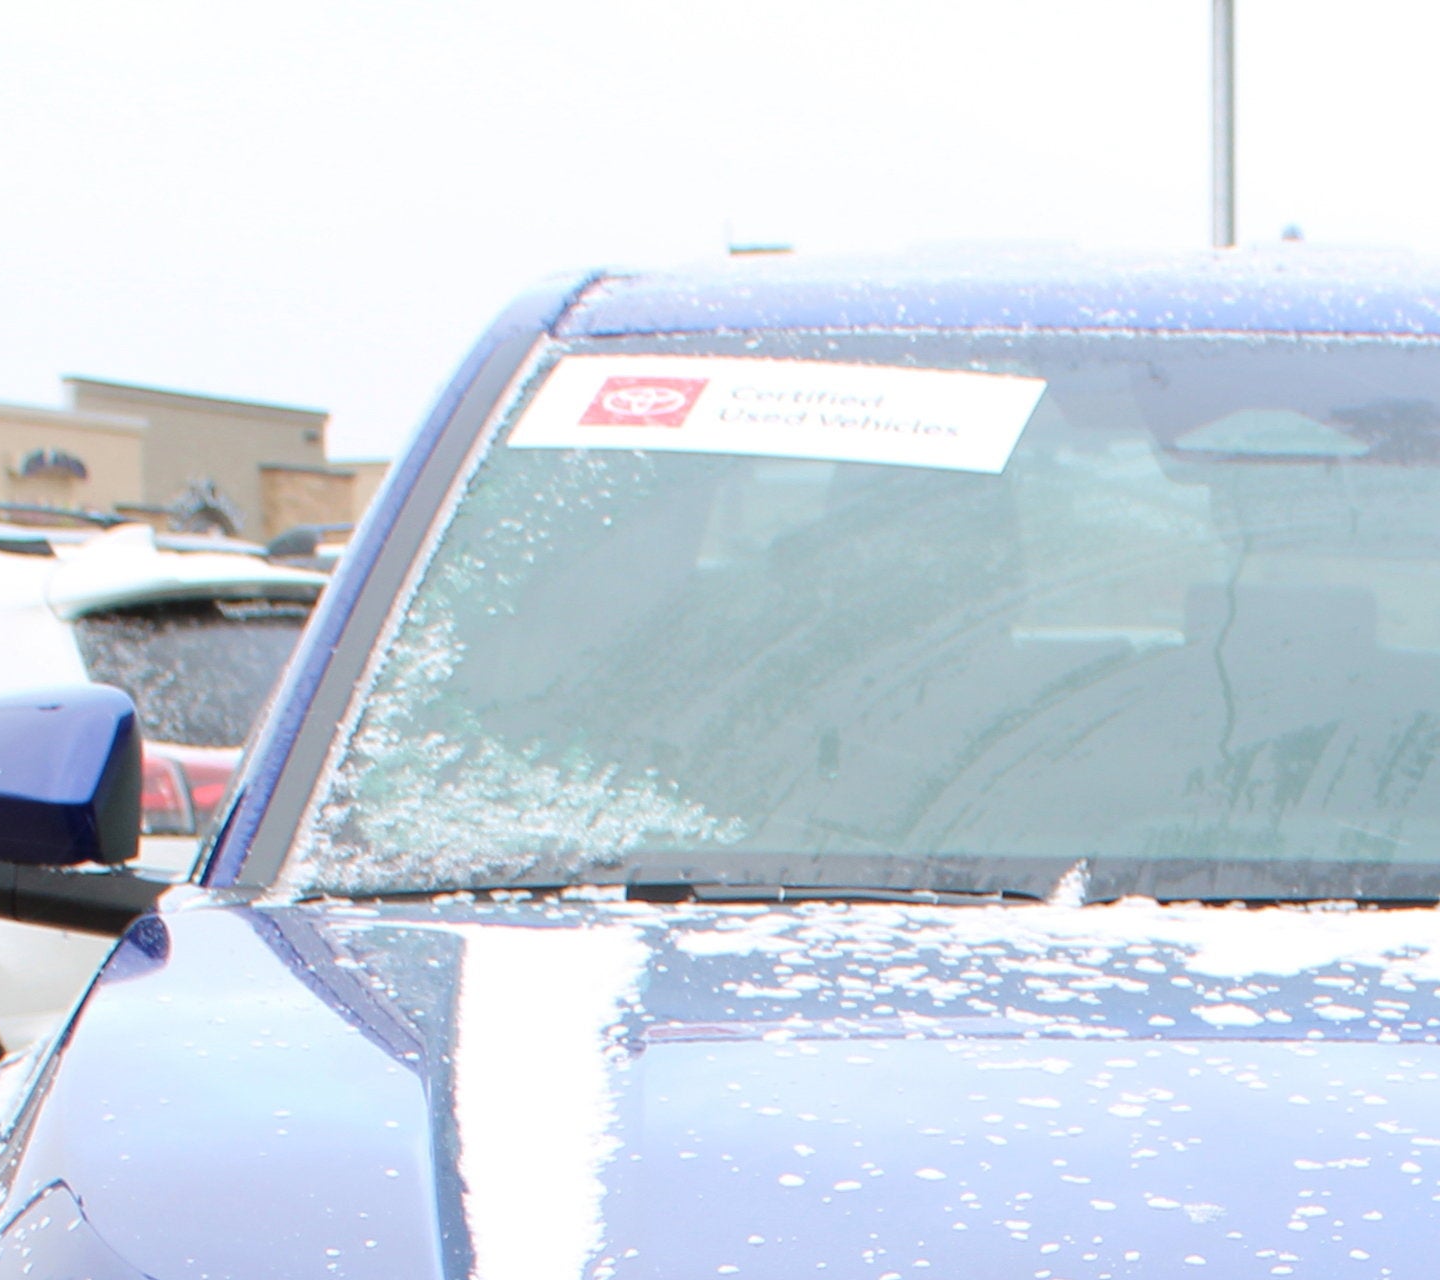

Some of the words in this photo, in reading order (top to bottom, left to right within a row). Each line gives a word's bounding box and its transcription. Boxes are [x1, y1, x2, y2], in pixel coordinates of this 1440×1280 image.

[731, 385, 886, 409] Certified
[719, 407, 807, 425] Used
[820, 410, 960, 437] Vehicles
